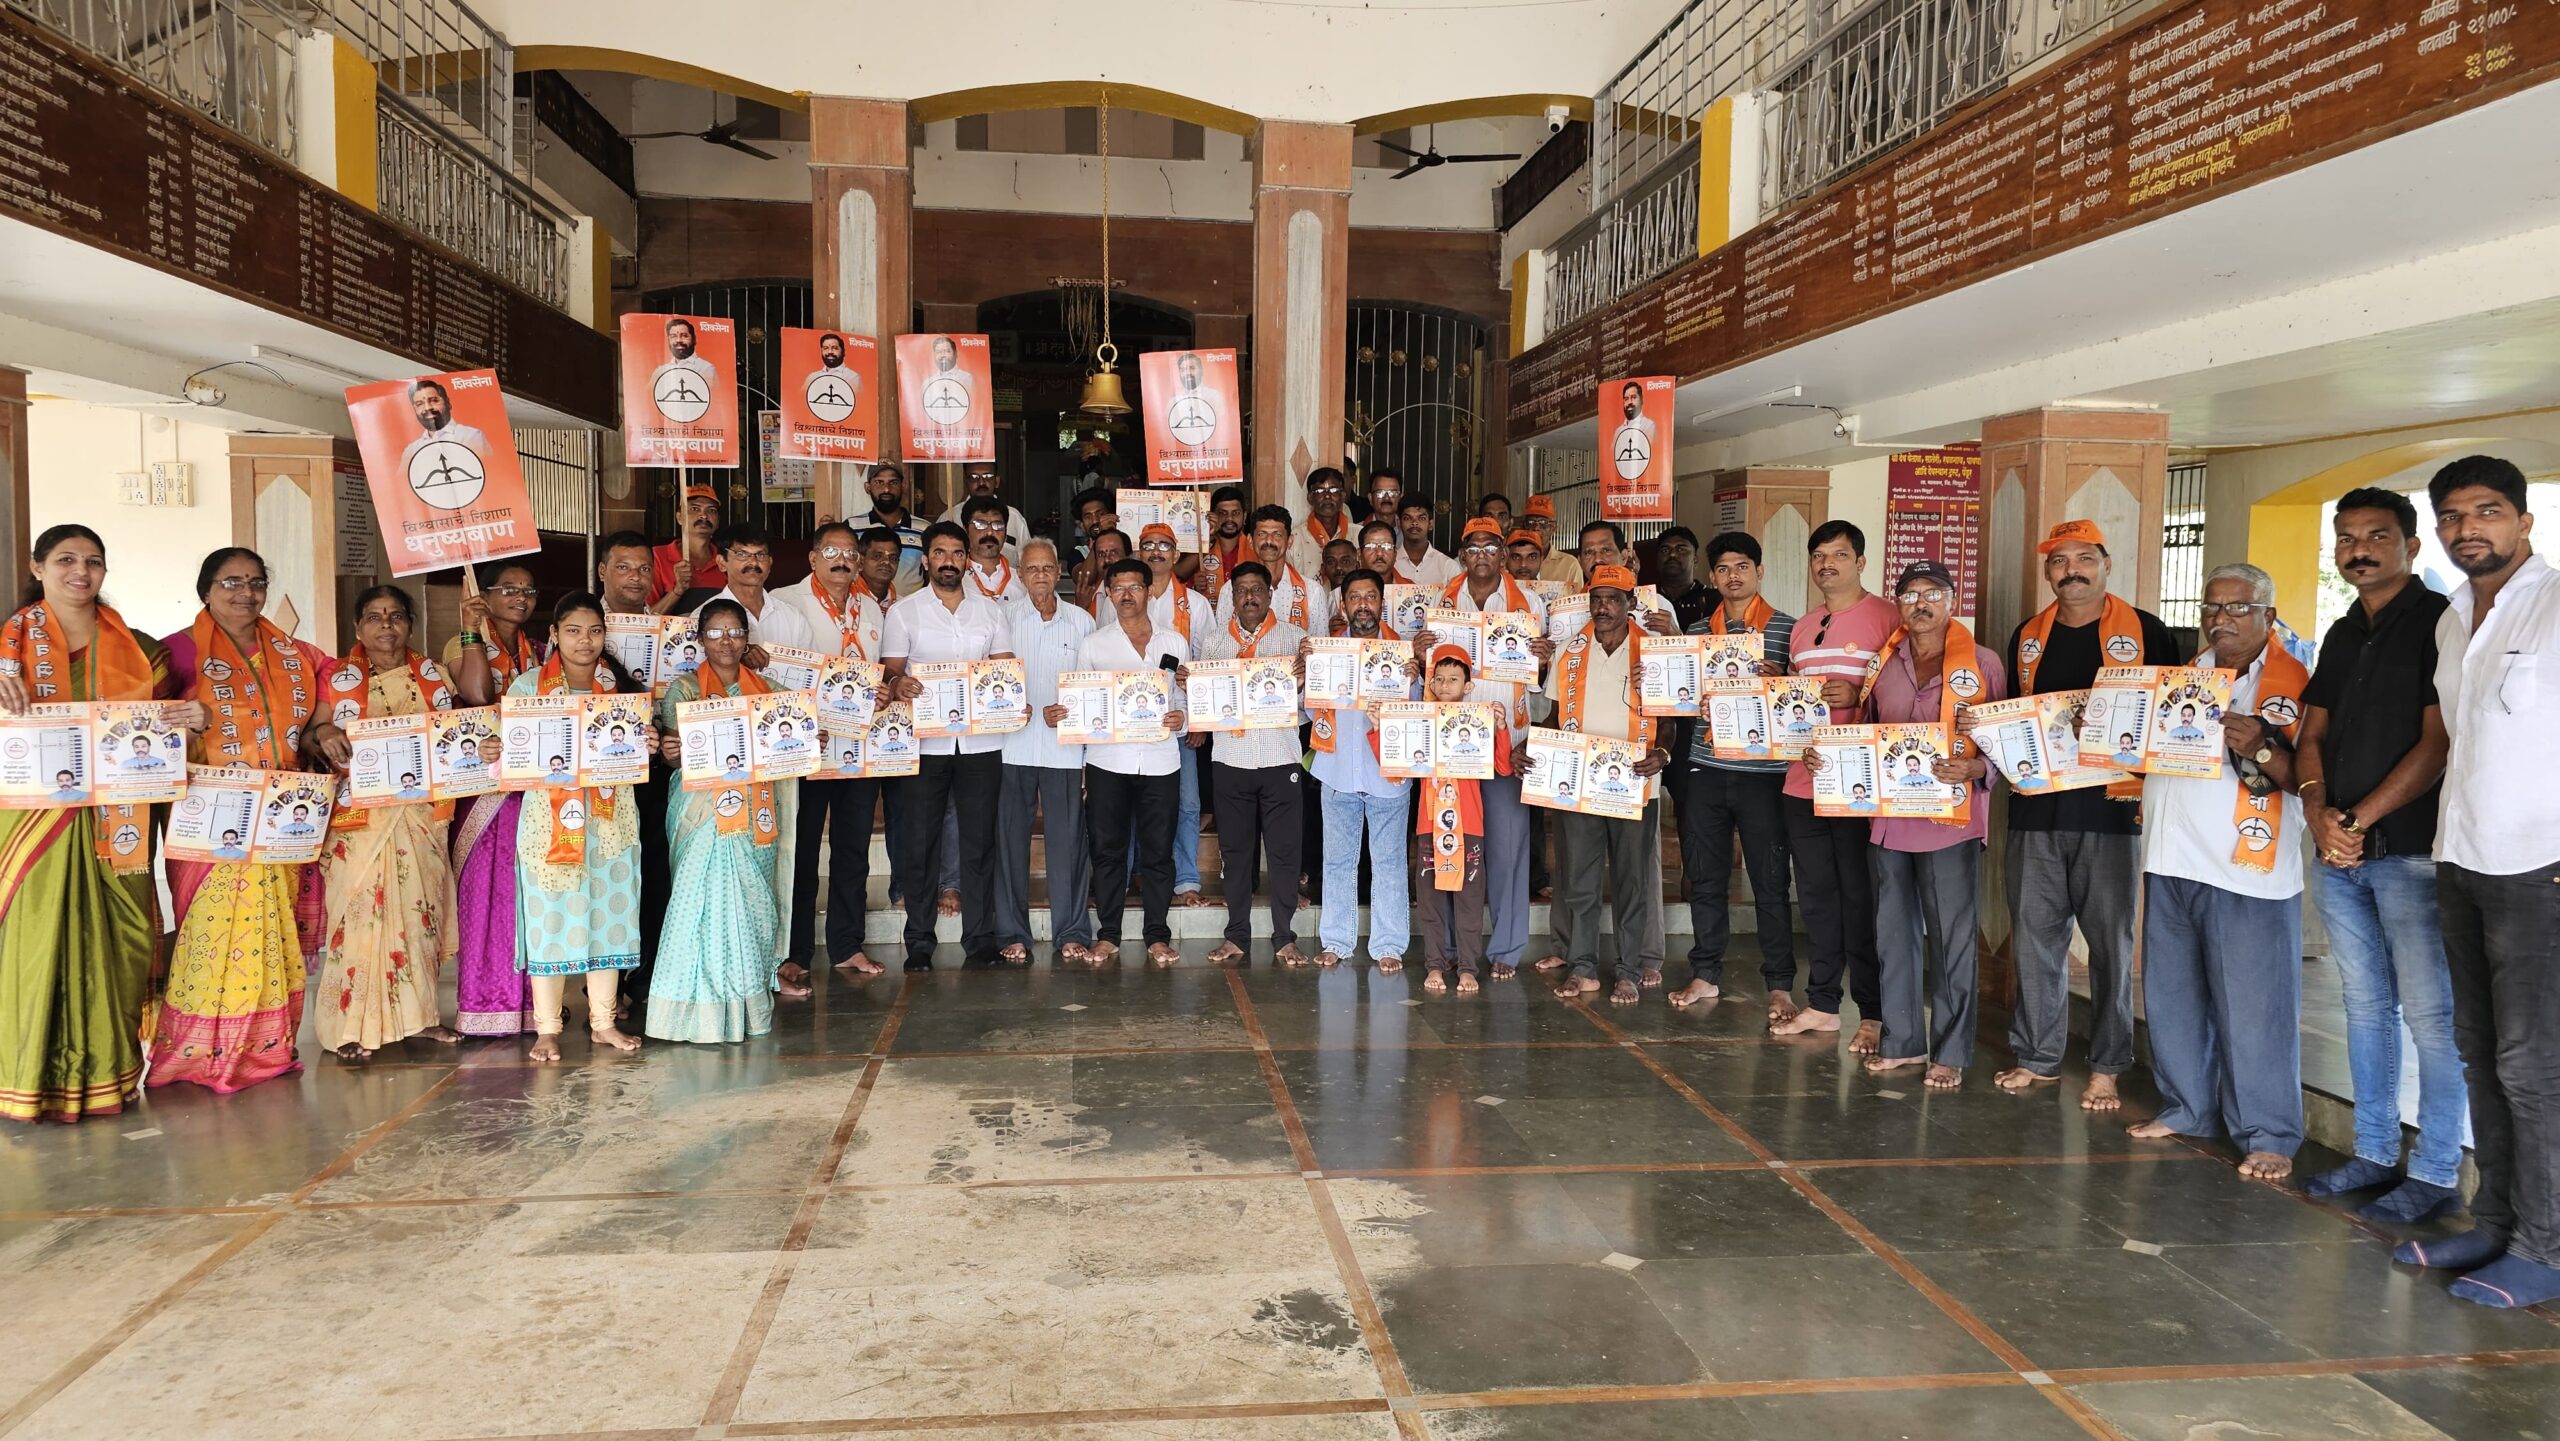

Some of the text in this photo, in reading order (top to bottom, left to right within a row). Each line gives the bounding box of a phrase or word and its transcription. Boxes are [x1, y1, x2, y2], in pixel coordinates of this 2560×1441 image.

[700, 322, 729, 333] शिवसेना
[849, 338, 874, 349] शिवसेना
[961, 338, 986, 348] शिवसेना
[1207, 354, 1232, 362] शिवसेना
[452, 377, 492, 390] शिवसेना
[1647, 381, 1671, 391] शिवसेना
[642, 424, 724, 437] विश्वासाचे निशाण
[794, 422, 866, 436] विश्वासाचे निशाण
[640, 434, 724, 456] धनुष्यबाण
[793, 432, 866, 453] धनुष्यबाण
[912, 435, 983, 455] धनुष्यबाण
[1159, 457, 1230, 476] धनुष्यबाण
[1607, 494, 1660, 512] धनुष्यबाण
[403, 508, 512, 535] विश्वासाचे निशाण
[404, 520, 515, 558] धनुष्यबाण
